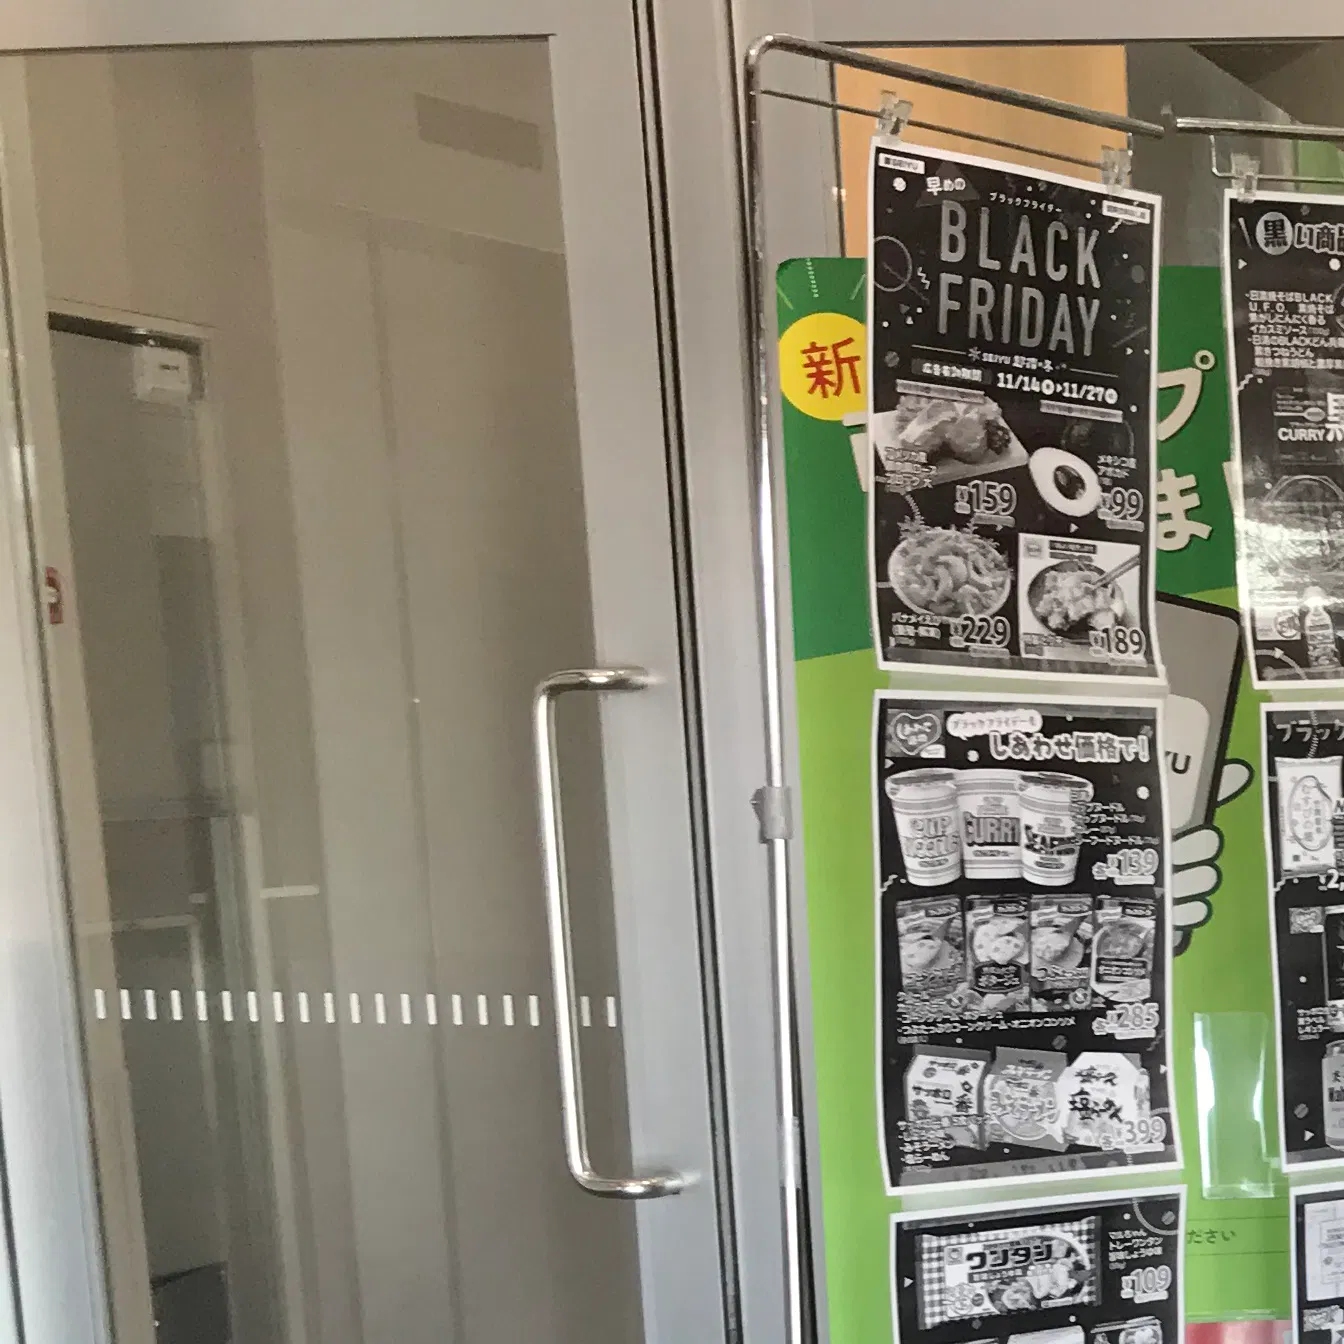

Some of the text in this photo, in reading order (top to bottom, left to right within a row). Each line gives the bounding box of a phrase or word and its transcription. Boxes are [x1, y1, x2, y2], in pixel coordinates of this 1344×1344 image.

[940, 200, 1100, 288] BLACK
[939, 272, 1100, 356] FRIDAY
[801, 338, 861, 399] 新
[1278, 427, 1326, 441] CURRY
